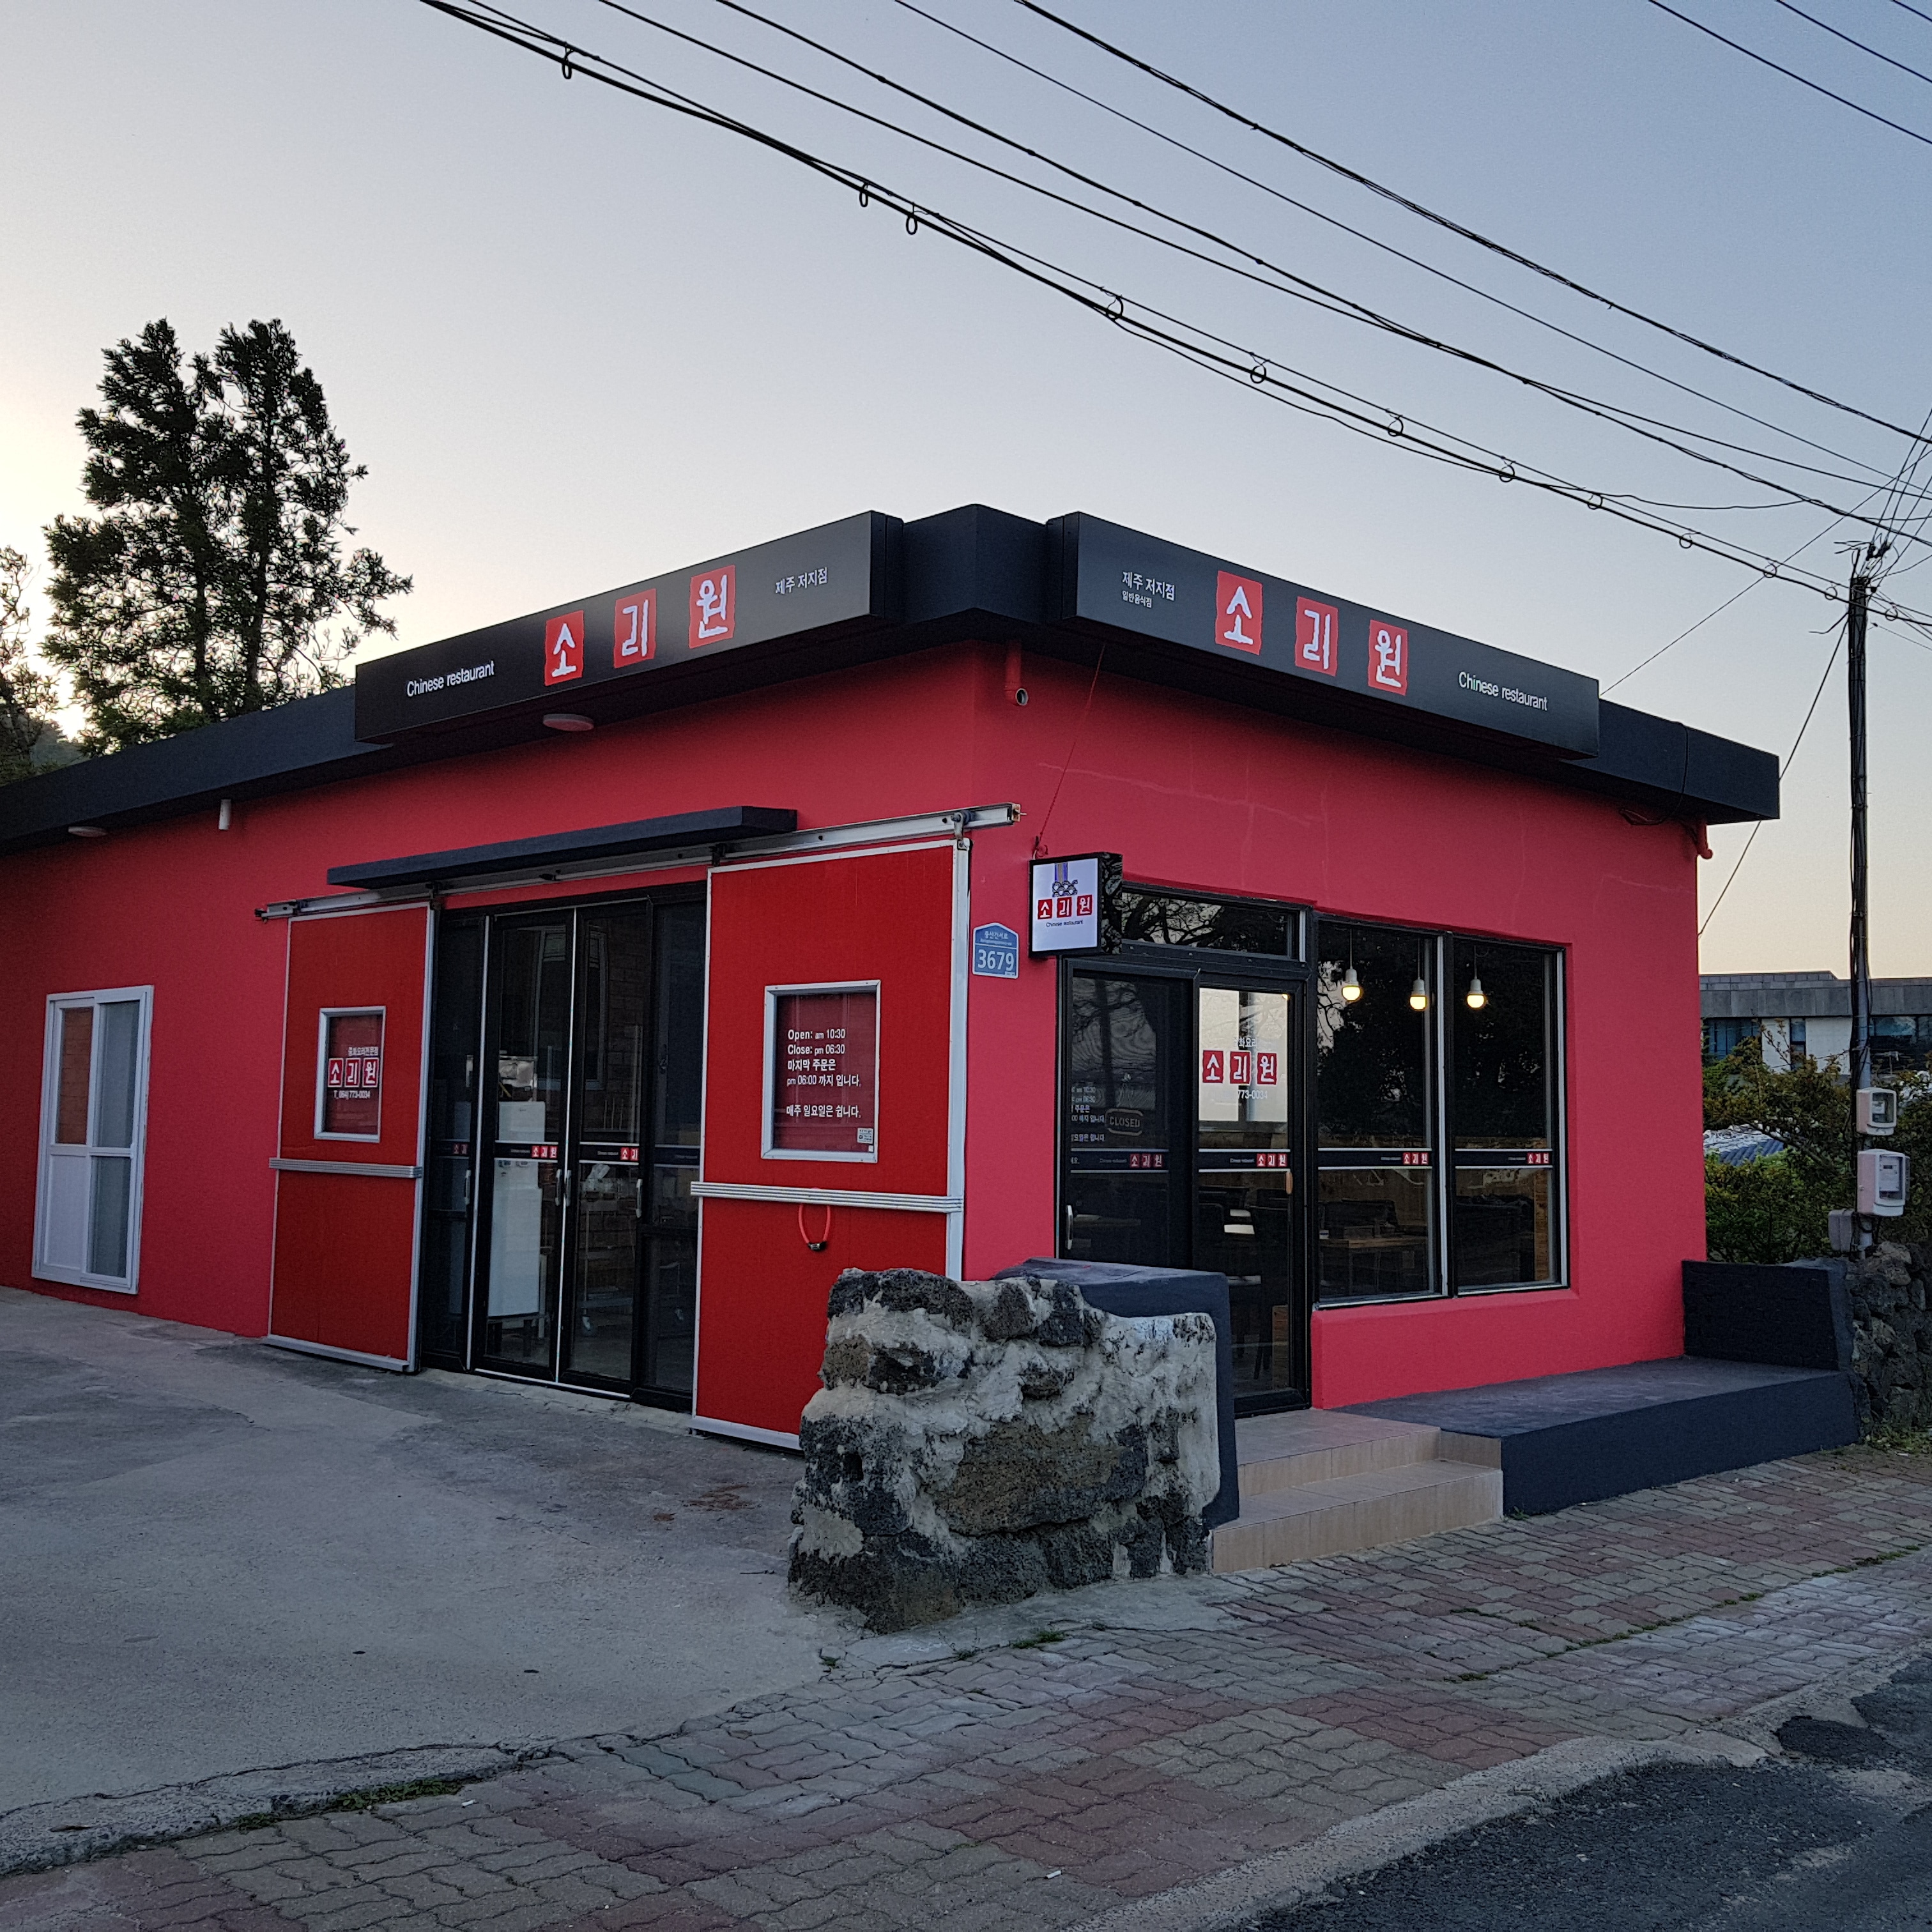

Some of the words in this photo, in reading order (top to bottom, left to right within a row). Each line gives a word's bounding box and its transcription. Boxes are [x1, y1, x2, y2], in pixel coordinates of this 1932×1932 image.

[775, 576, 795, 595] 제주
[797, 567, 827, 588] 저지점
[1122, 571, 1144, 590] 제주
[1145, 578, 1176, 601] 저지점
[1122, 590, 1153, 608] 일반음식점
[551, 574, 728, 677] 소리원
[1225, 585, 1402, 687] 소리원
[407, 677, 444, 697] Chinese
[447, 660, 494, 687] restaurant
[1459, 671, 1499, 697] Chinese
[1501, 686, 1548, 711] restaurant
[1039, 896, 1091, 918] 소리원
[977, 949, 1015, 971] 3679
[787, 1029, 813, 1041] Open:
[827, 1028, 846, 1039] 10:30
[787, 1044, 813, 1055] Close:
[825, 1044, 845, 1055] 06:30
[330, 1061, 376, 1085] 소리원
[787, 1059, 810, 1071] 마지막
[813, 1059, 836, 1071] 주문은
[1206, 1054, 1275, 1083] 소리원
[786, 1078, 796, 1087] pm
[797, 1075, 817, 1085] 06:00
[818, 1074, 834, 1087] 까지
[786, 1104, 802, 1117] 매주
[803, 1104, 834, 1117] 일요일은
[1109, 1116, 1141, 1128] CLOSED
